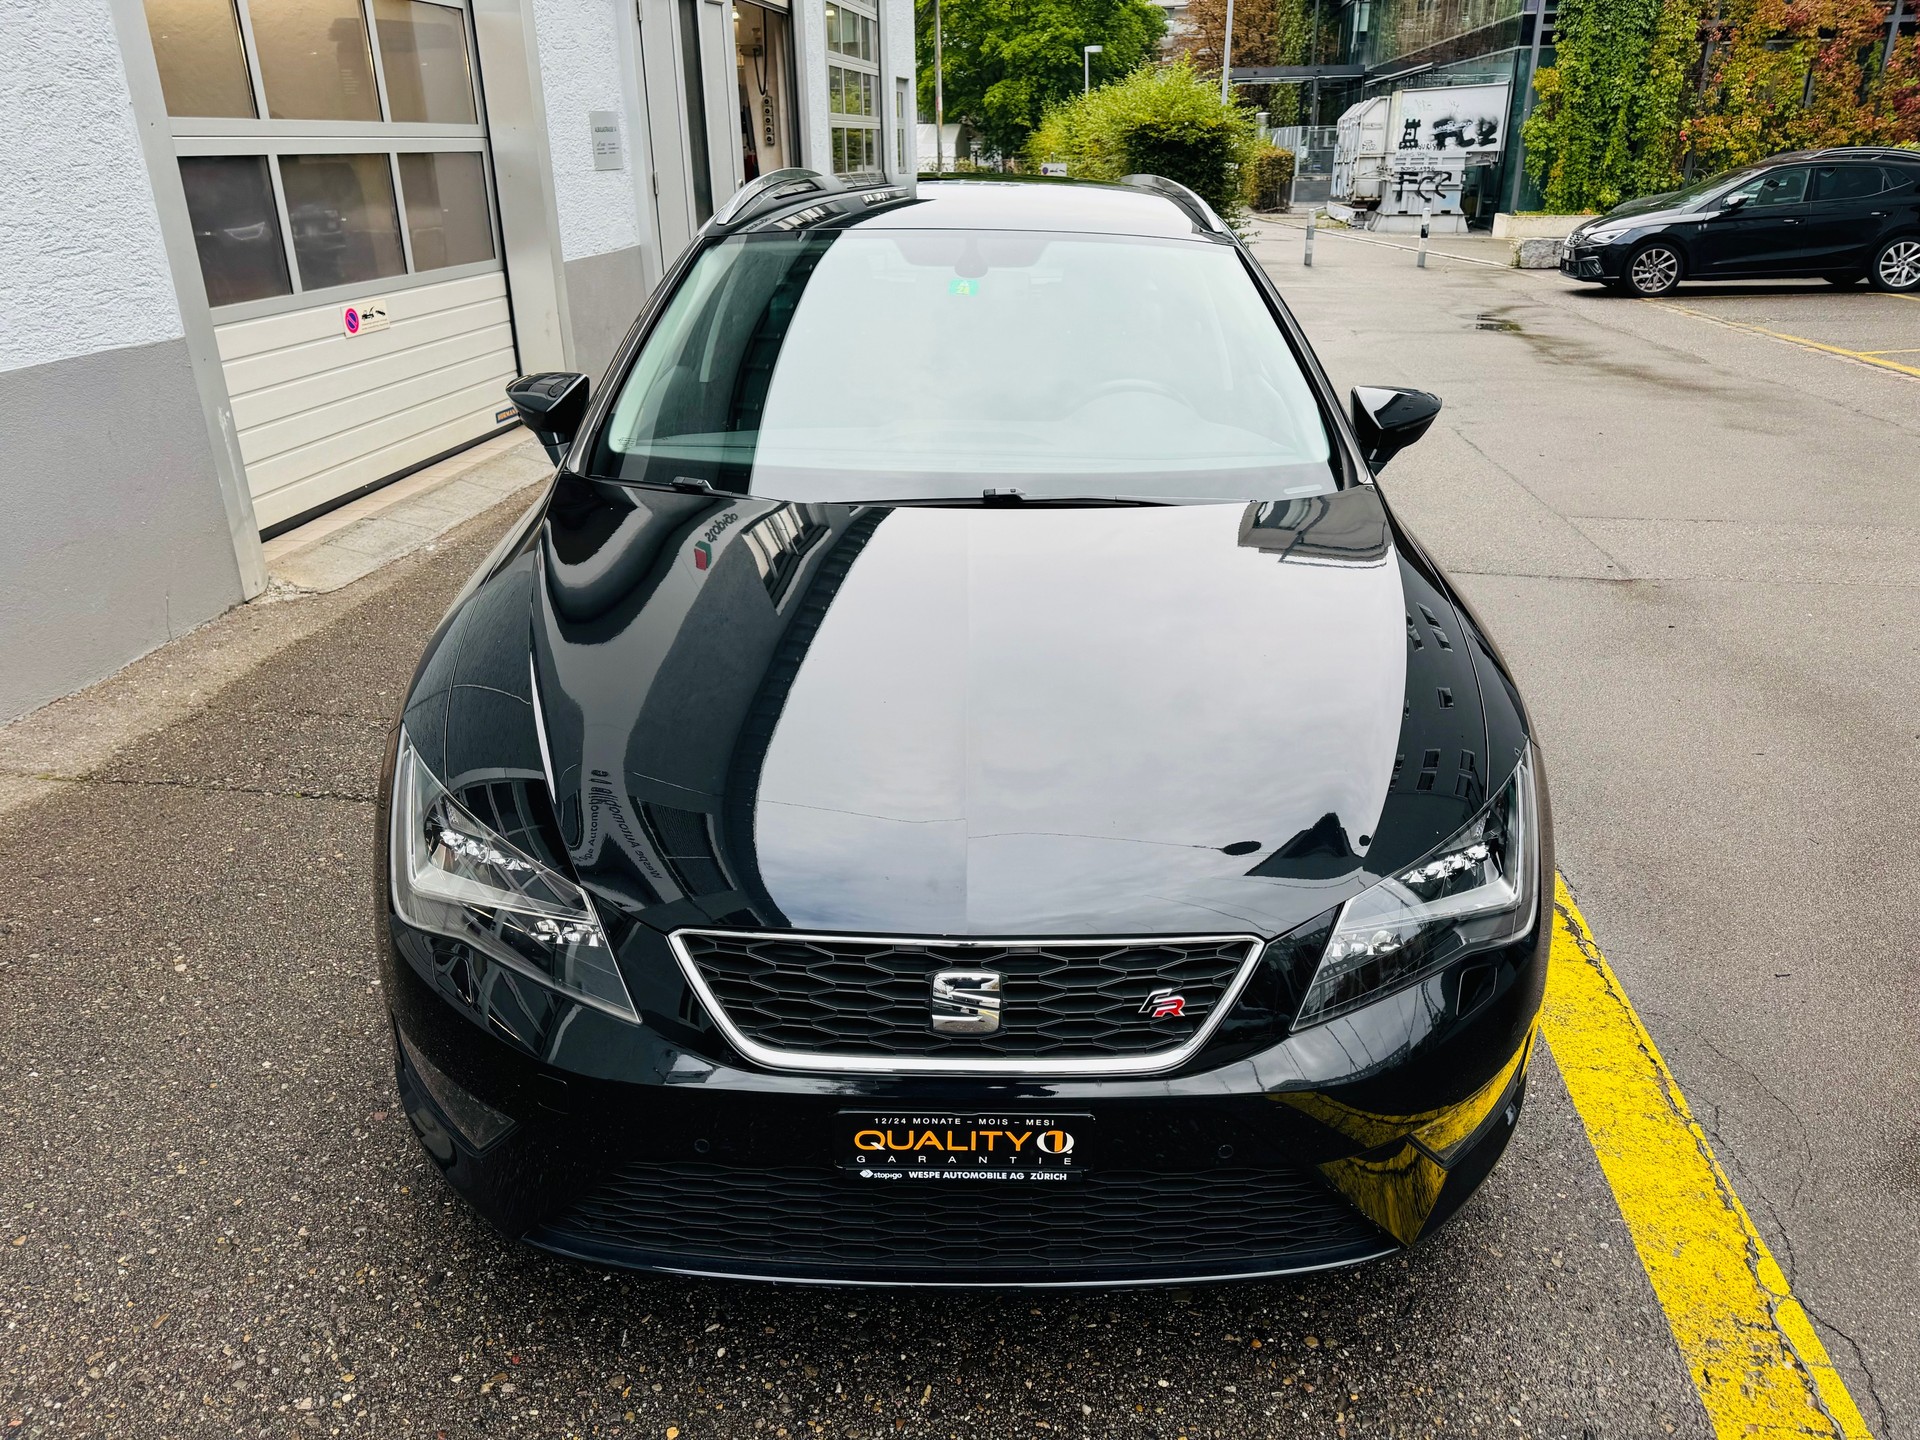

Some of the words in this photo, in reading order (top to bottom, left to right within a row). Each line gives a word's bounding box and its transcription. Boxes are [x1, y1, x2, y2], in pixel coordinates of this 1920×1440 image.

[1138, 988, 1185, 1017] FR
[1026, 1119, 1055, 1127] MESI
[854, 1130, 1033, 1151] QUALITY
[856, 1155, 1072, 1165] GARANTIE
[908, 1171, 941, 1179] WESPE
[943, 1171, 1007, 1180] AUTOMOBILE
[1009, 1172, 1025, 1180] AG
[1030, 1171, 1067, 1181] ZÜRICH
